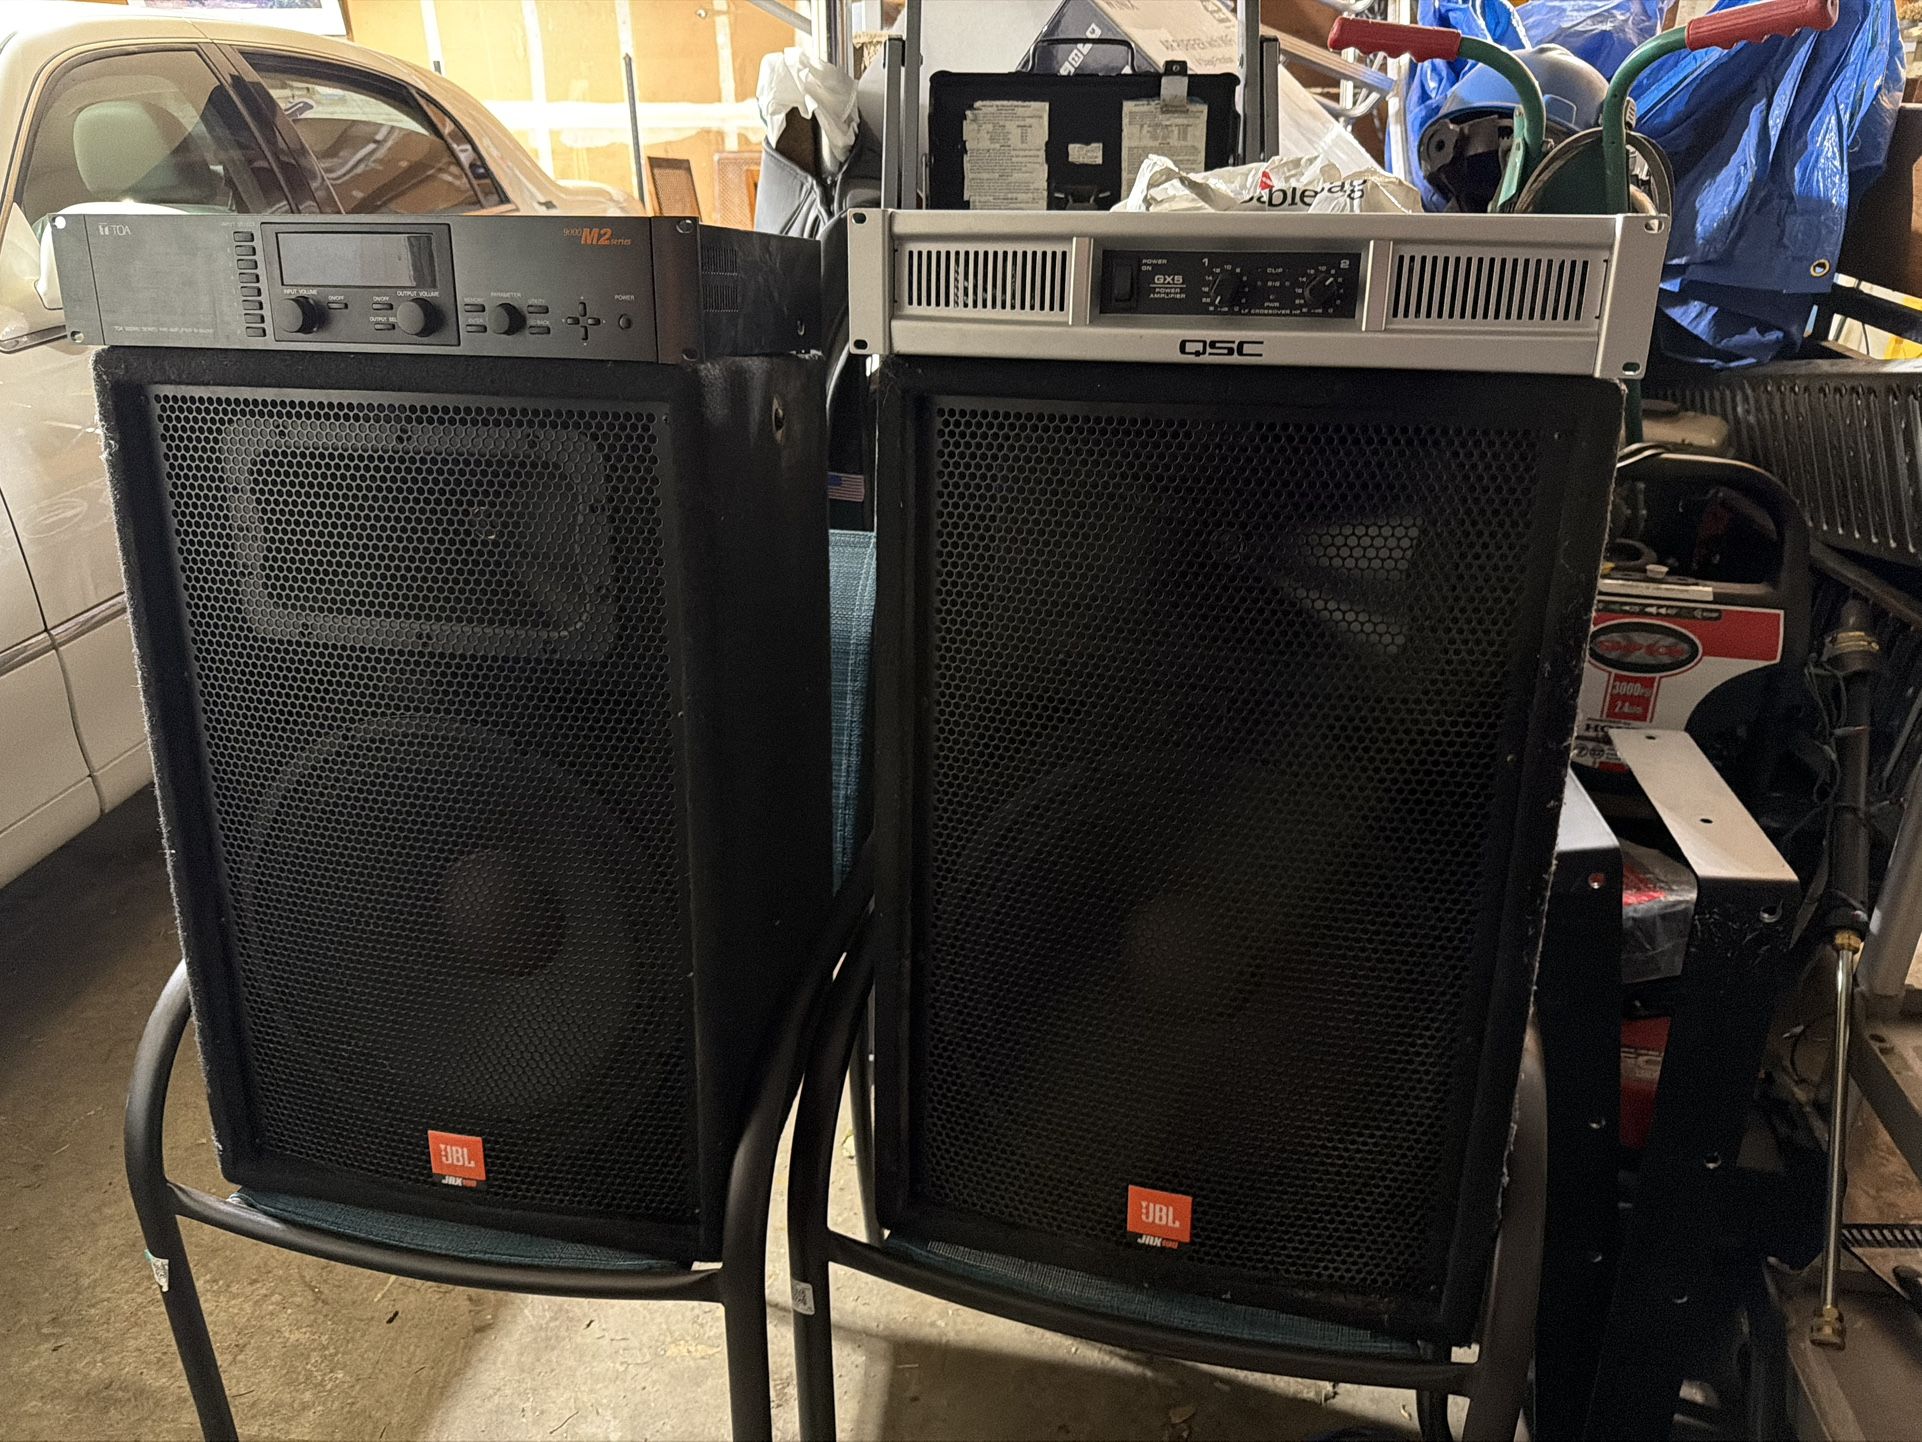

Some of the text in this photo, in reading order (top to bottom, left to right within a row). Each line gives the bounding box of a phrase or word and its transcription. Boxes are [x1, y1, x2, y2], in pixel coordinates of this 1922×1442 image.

[111, 225, 132, 236] TOA
[582, 228, 612, 245] M2
[1154, 275, 1183, 285] GX5
[1179, 339, 1264, 357] QSC
[439, 1143, 476, 1168] JBL
[1141, 1200, 1180, 1228] JBL
